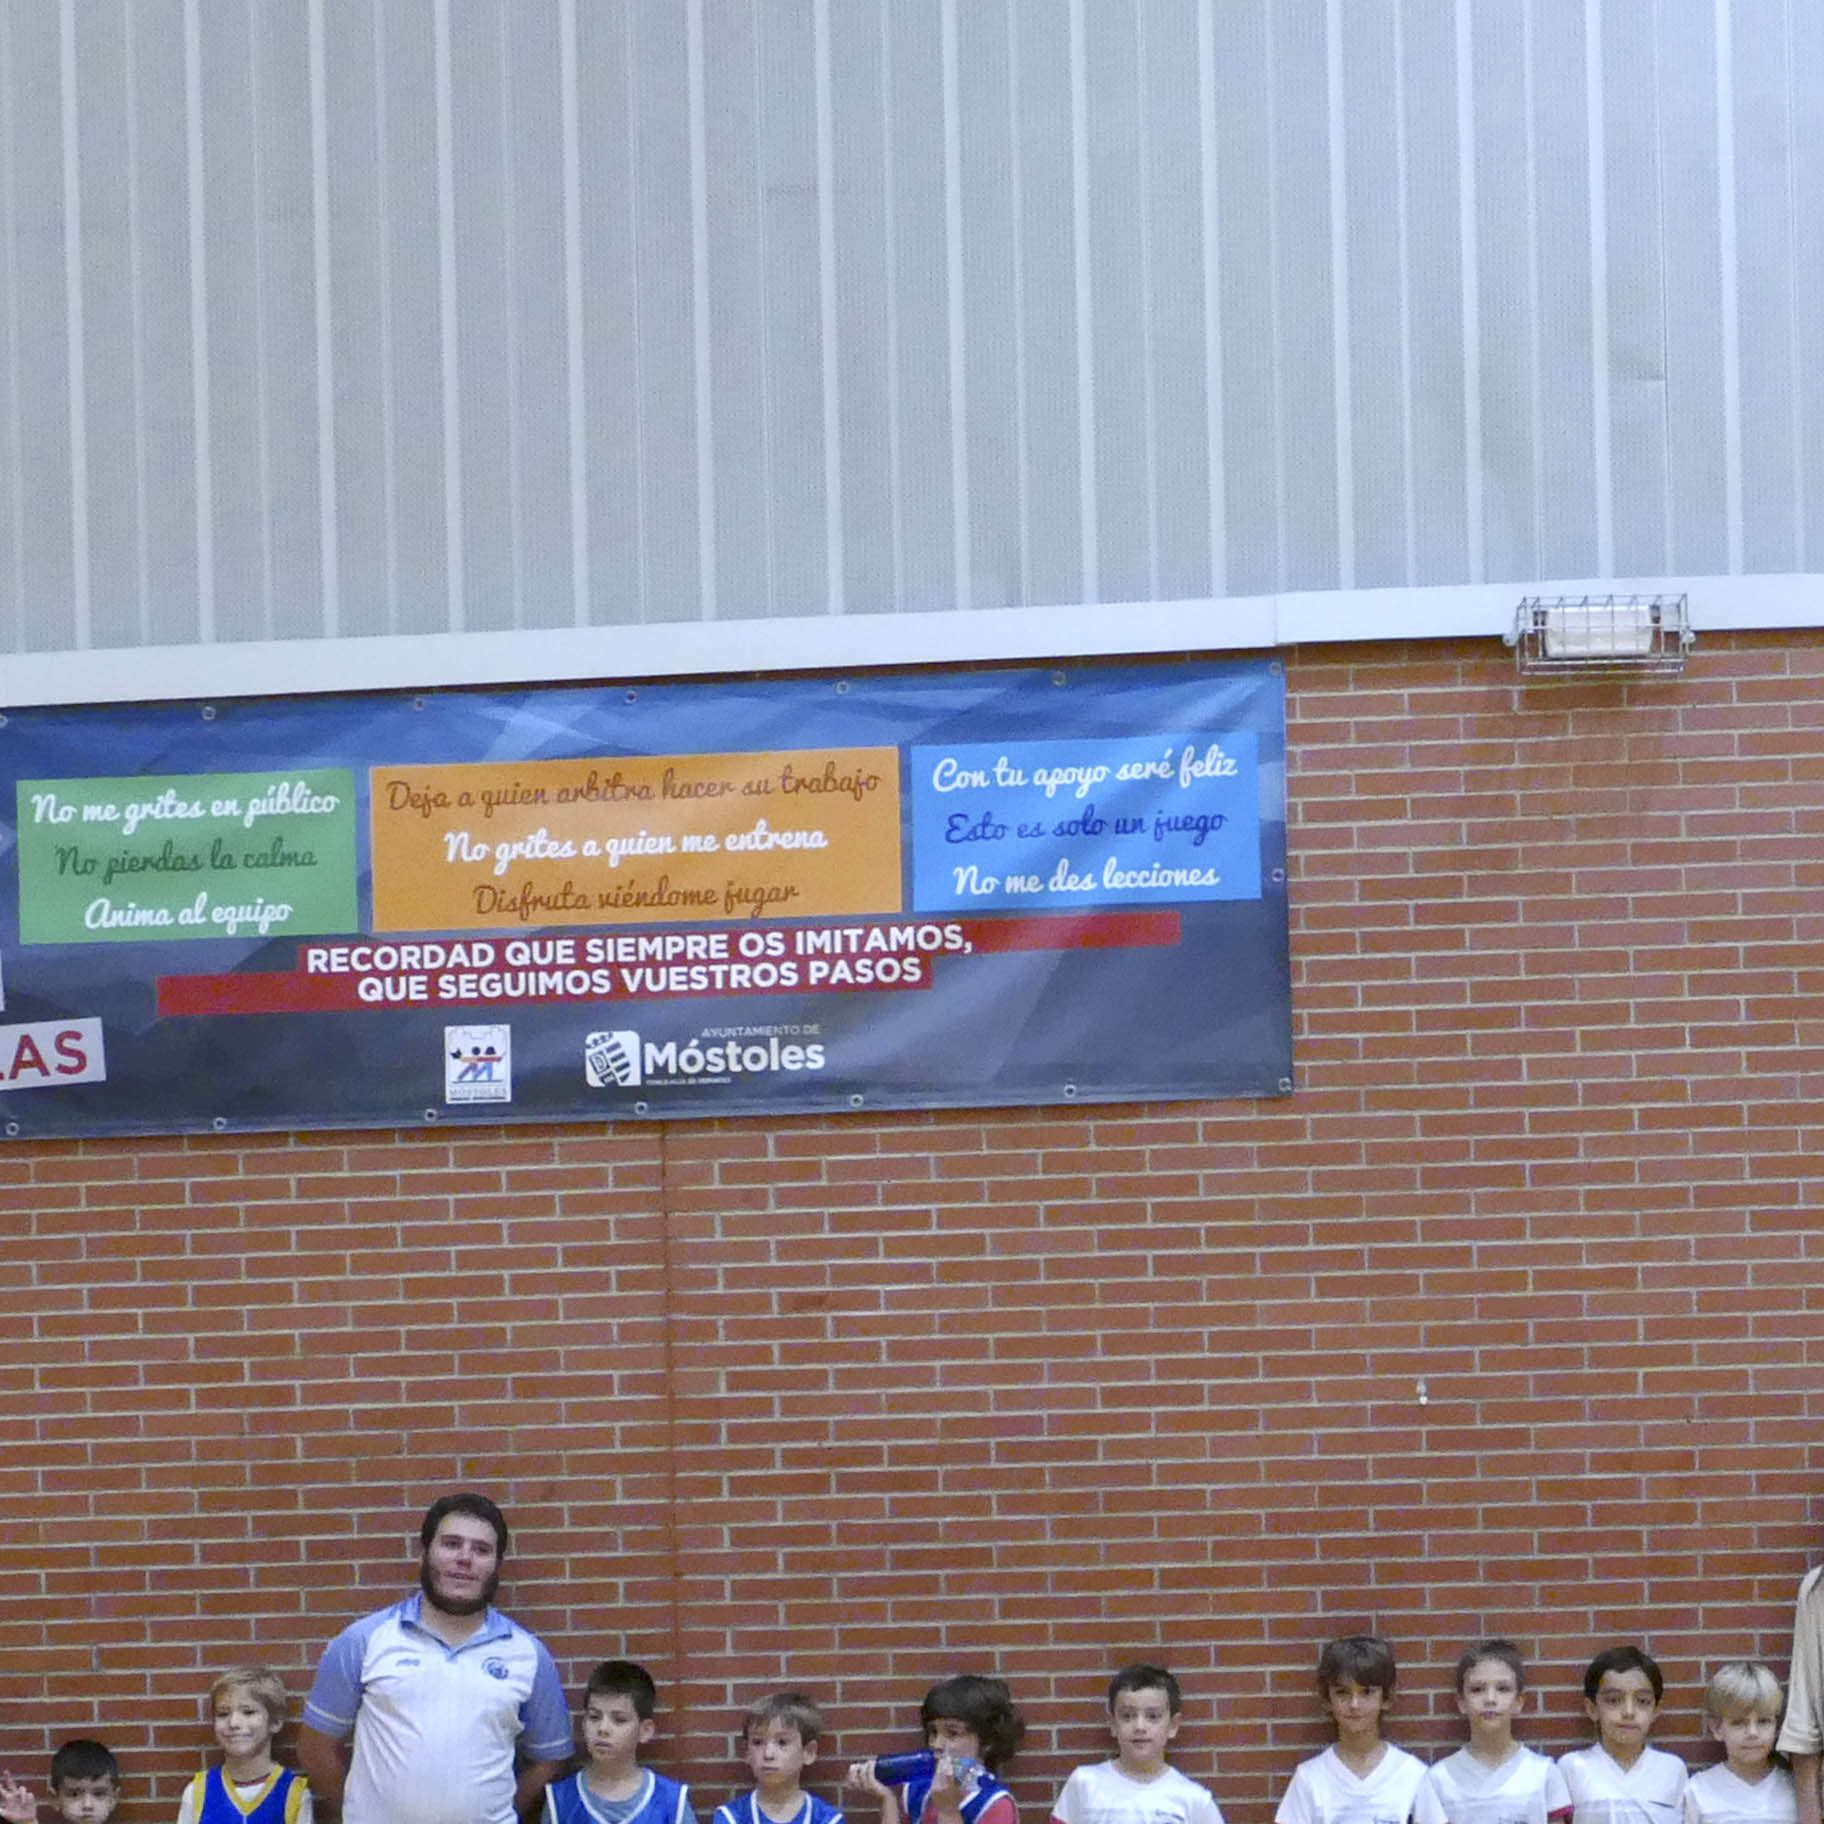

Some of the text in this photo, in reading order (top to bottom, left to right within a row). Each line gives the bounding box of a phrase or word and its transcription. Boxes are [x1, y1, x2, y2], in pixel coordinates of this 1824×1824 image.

[386, 761, 880, 818] Deja a quien arbitra hacer su trabajo
[932, 744, 1238, 798] Con tu apoyo seré feliz
[32, 781, 340, 835] No me grites en público
[944, 803, 1228, 846] Esto es solo un juego
[55, 835, 318, 885] No pierdas la calma
[444, 818, 829, 877] No grites a quien me entrena
[473, 875, 799, 921] Disfruta viéndome jugar
[953, 856, 1221, 896] No me des lecciones
[84, 891, 293, 935] Anima al equipo
[307, 925, 973, 974] RECORDAD QUE SIEMPRE OS IMITAMOS,
[357, 957, 922, 1003] QUE SEGUIMOS VUESTROS PASOS
[701, 1024, 821, 1039] AYUNTAMIENTO DE
[644, 1037, 826, 1075] Móstoles
